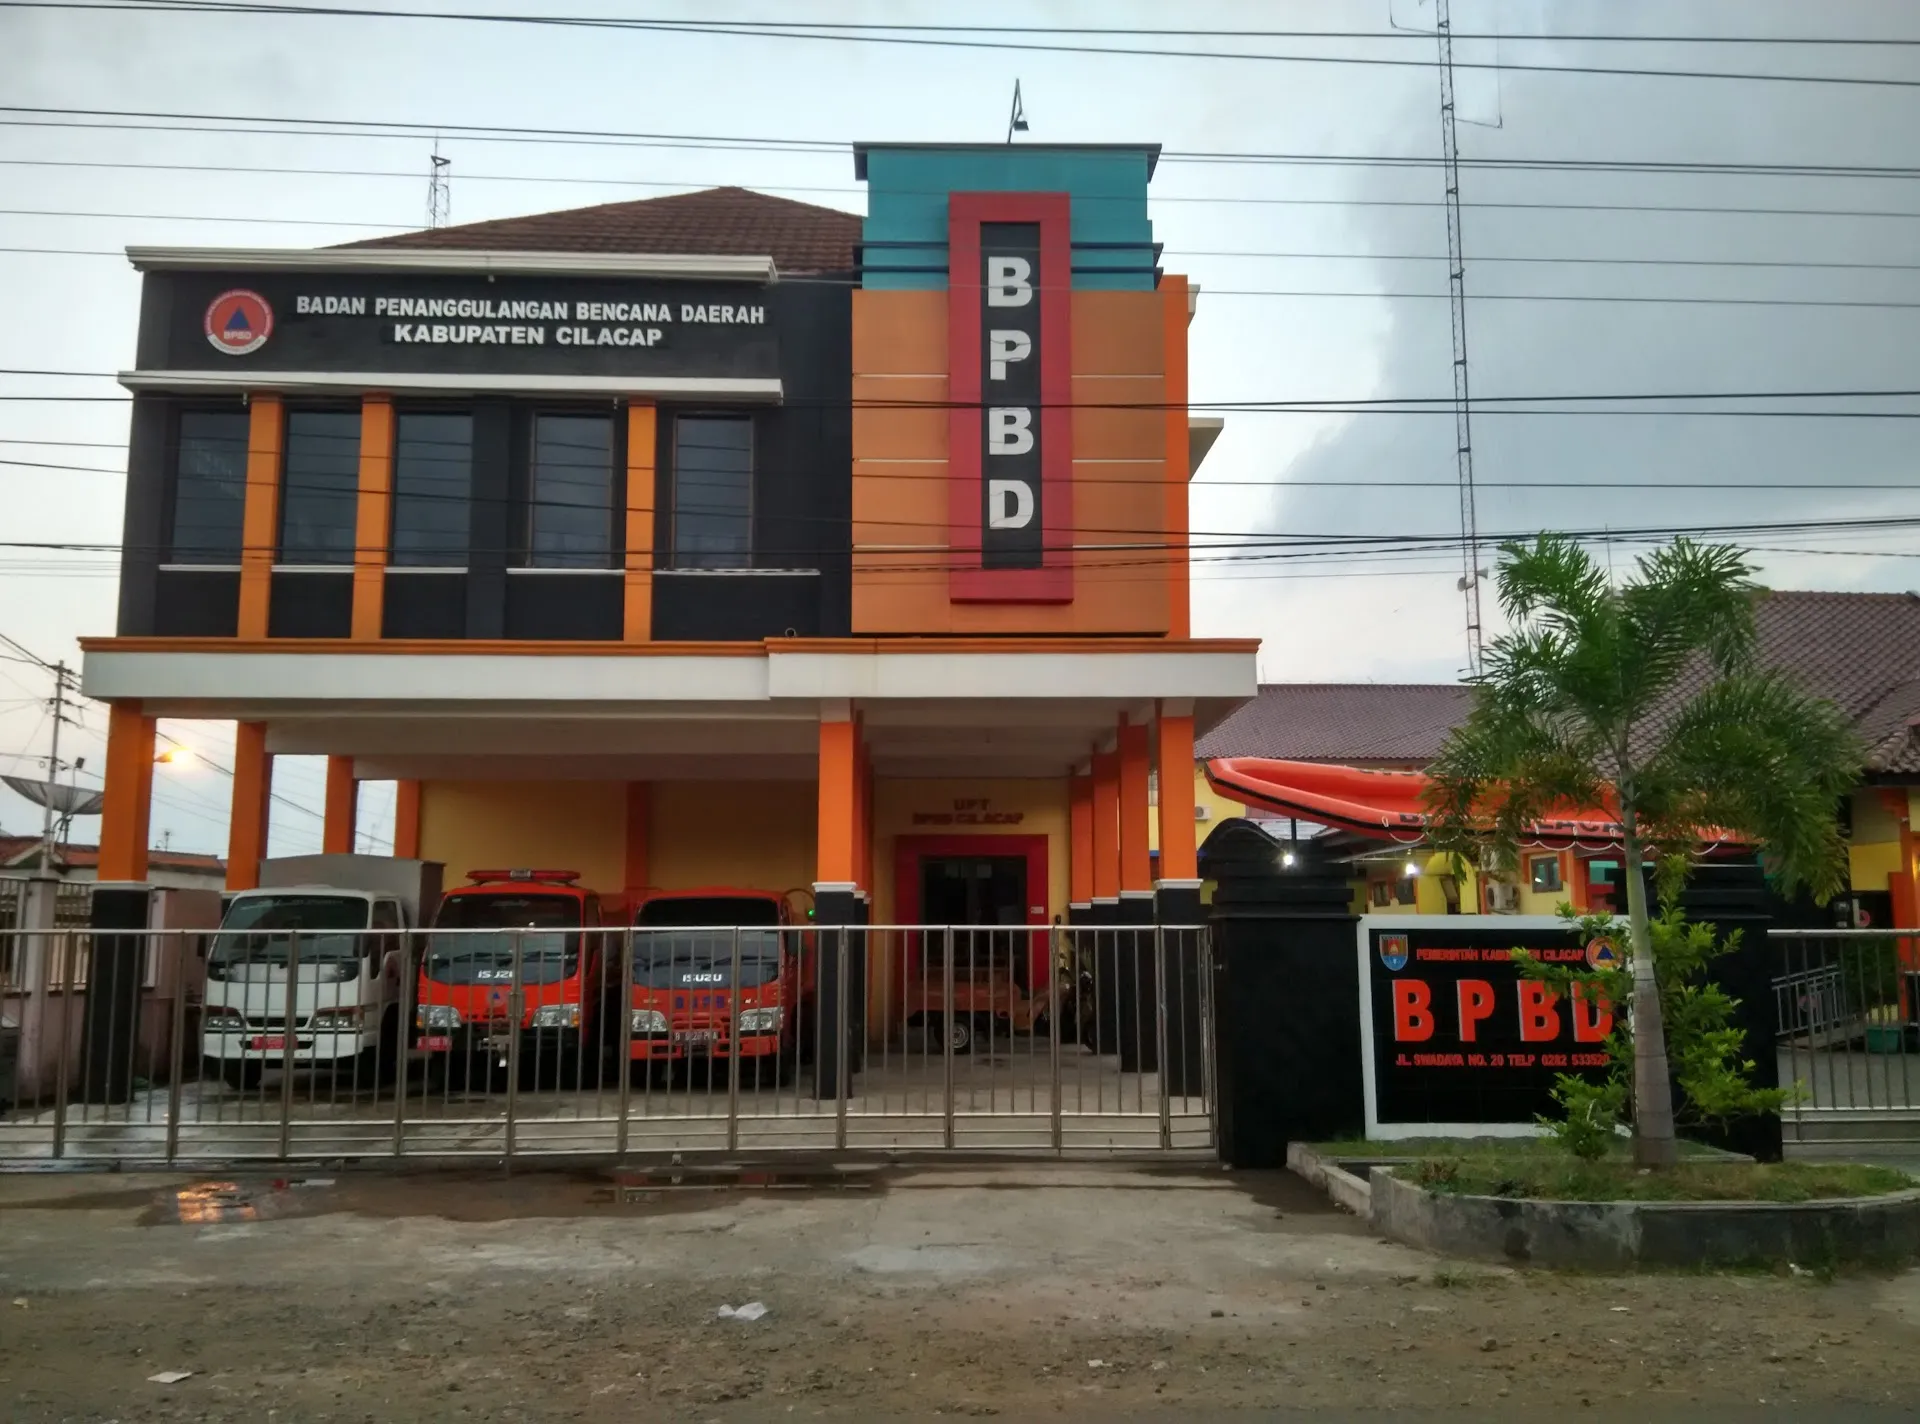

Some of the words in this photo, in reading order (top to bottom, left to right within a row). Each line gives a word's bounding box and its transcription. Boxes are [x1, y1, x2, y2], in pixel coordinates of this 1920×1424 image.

[296, 296, 366, 315] BADAN
[374, 297, 569, 320] PENANGGULANGAN
[576, 302, 672, 322] BENCANA
[681, 304, 765, 324] DAERAH
[394, 324, 545, 345] KABUPATEN
[555, 326, 663, 346] CILACAP
[988, 256, 1035, 529] BPBD
[1543, 948, 1585, 961] CILACAP
[682, 974, 722, 982] ISUZU
[1490, 1054, 1505, 1067] 20
[1508, 1054, 1536, 1067] TELP
